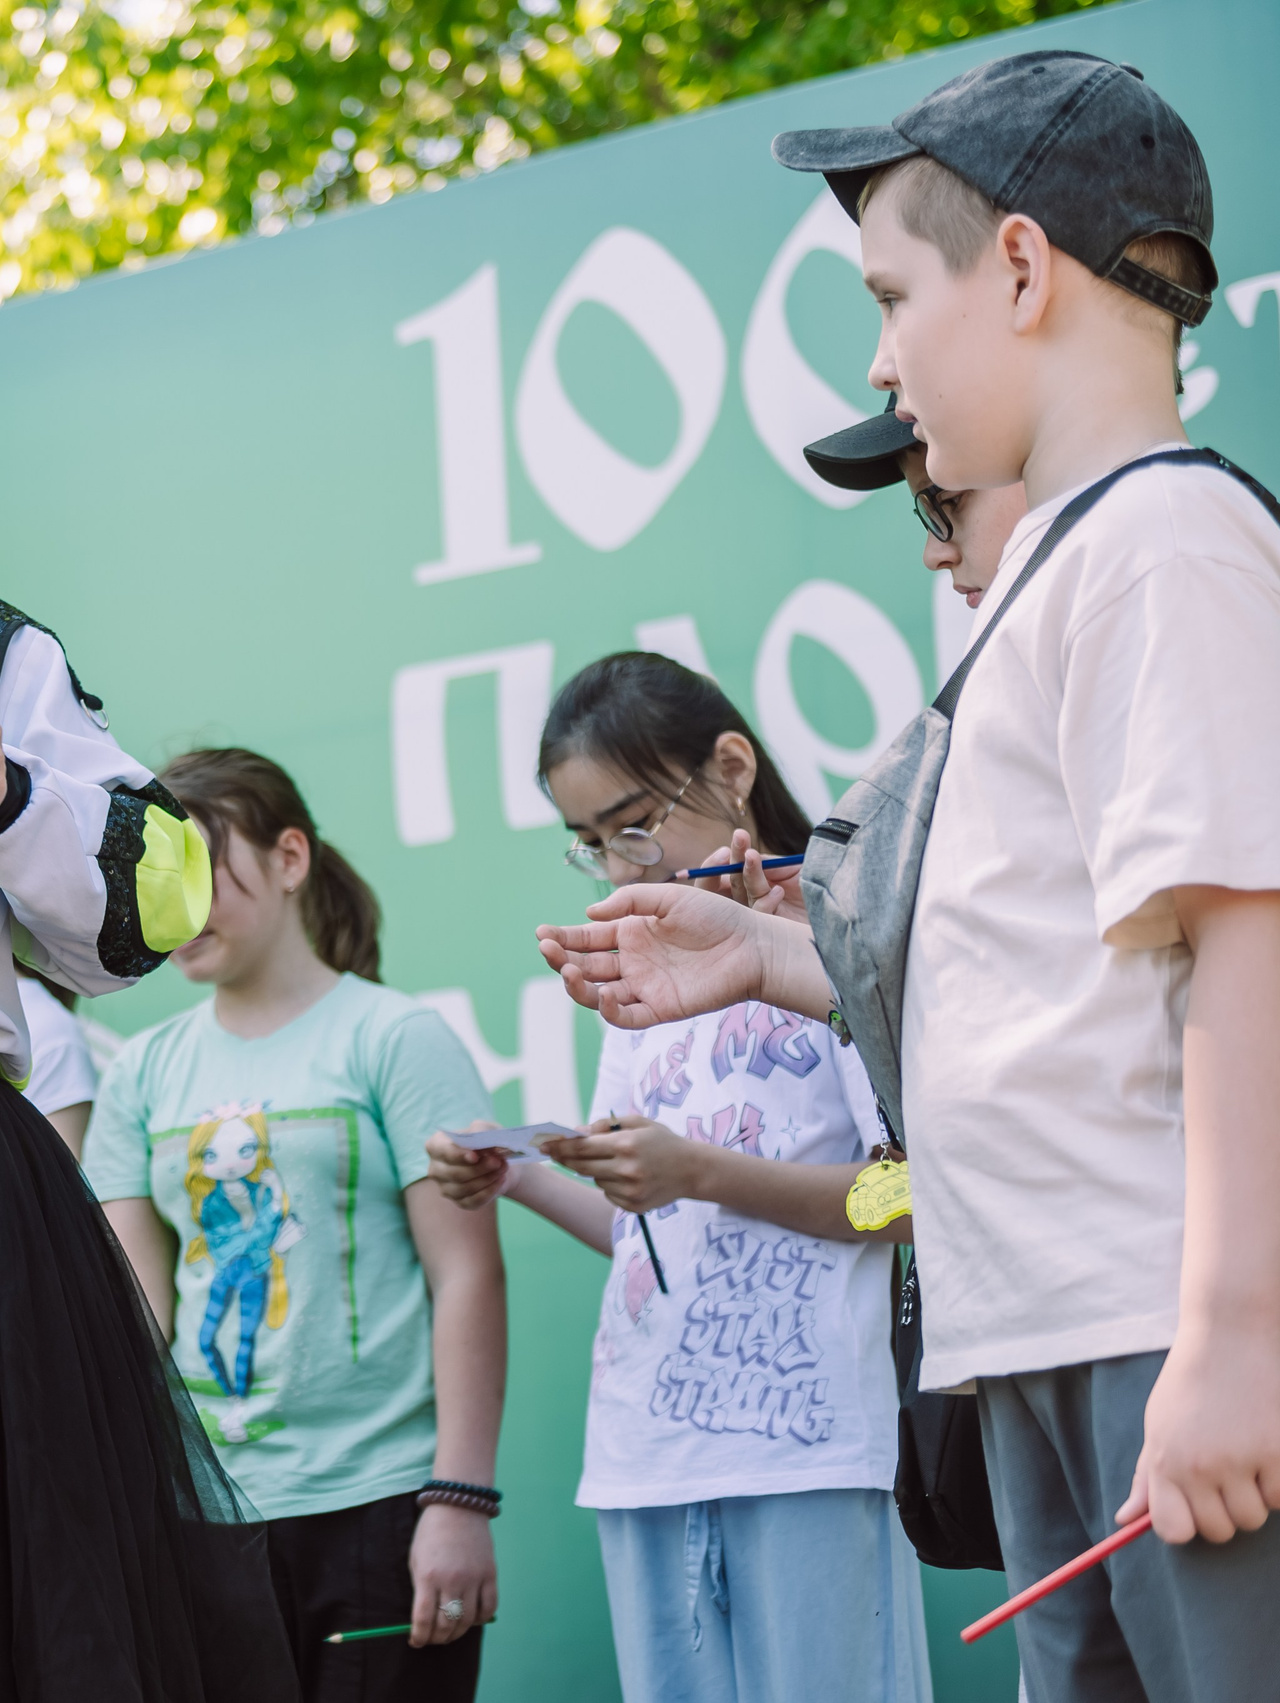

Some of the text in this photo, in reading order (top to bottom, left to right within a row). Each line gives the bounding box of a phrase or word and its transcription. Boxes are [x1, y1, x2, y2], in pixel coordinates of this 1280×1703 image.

[696, 1222, 838, 1300] JUST
[680, 1287, 824, 1376] STAY
[649, 1351, 835, 1446] STRONG
